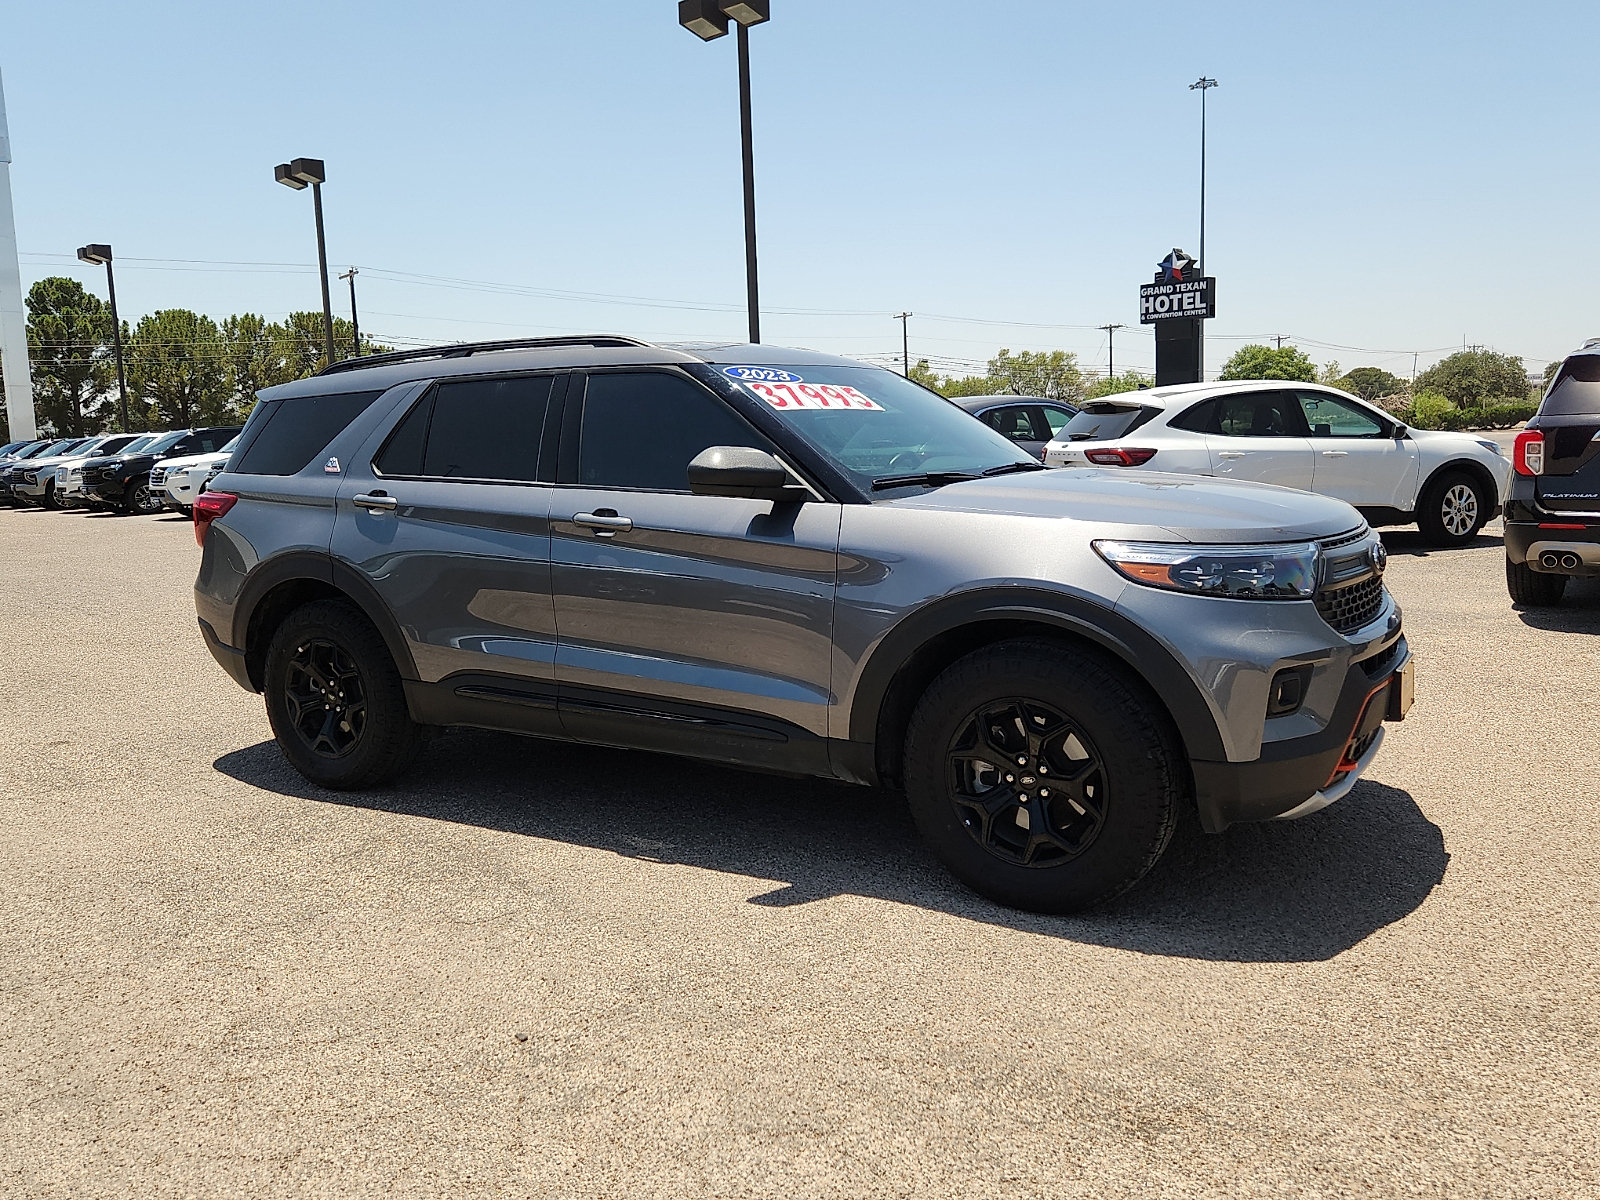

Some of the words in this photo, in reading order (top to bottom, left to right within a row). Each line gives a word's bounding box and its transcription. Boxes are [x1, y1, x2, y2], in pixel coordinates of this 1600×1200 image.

[1141, 285, 1173, 296] GRAND
[1175, 281, 1206, 292] TEXAN
[1140, 292, 1206, 314] HOTEL
[1146, 311, 1183, 319] CONVENTION
[737, 368, 792, 381] 2023
[752, 384, 873, 408] 37995
